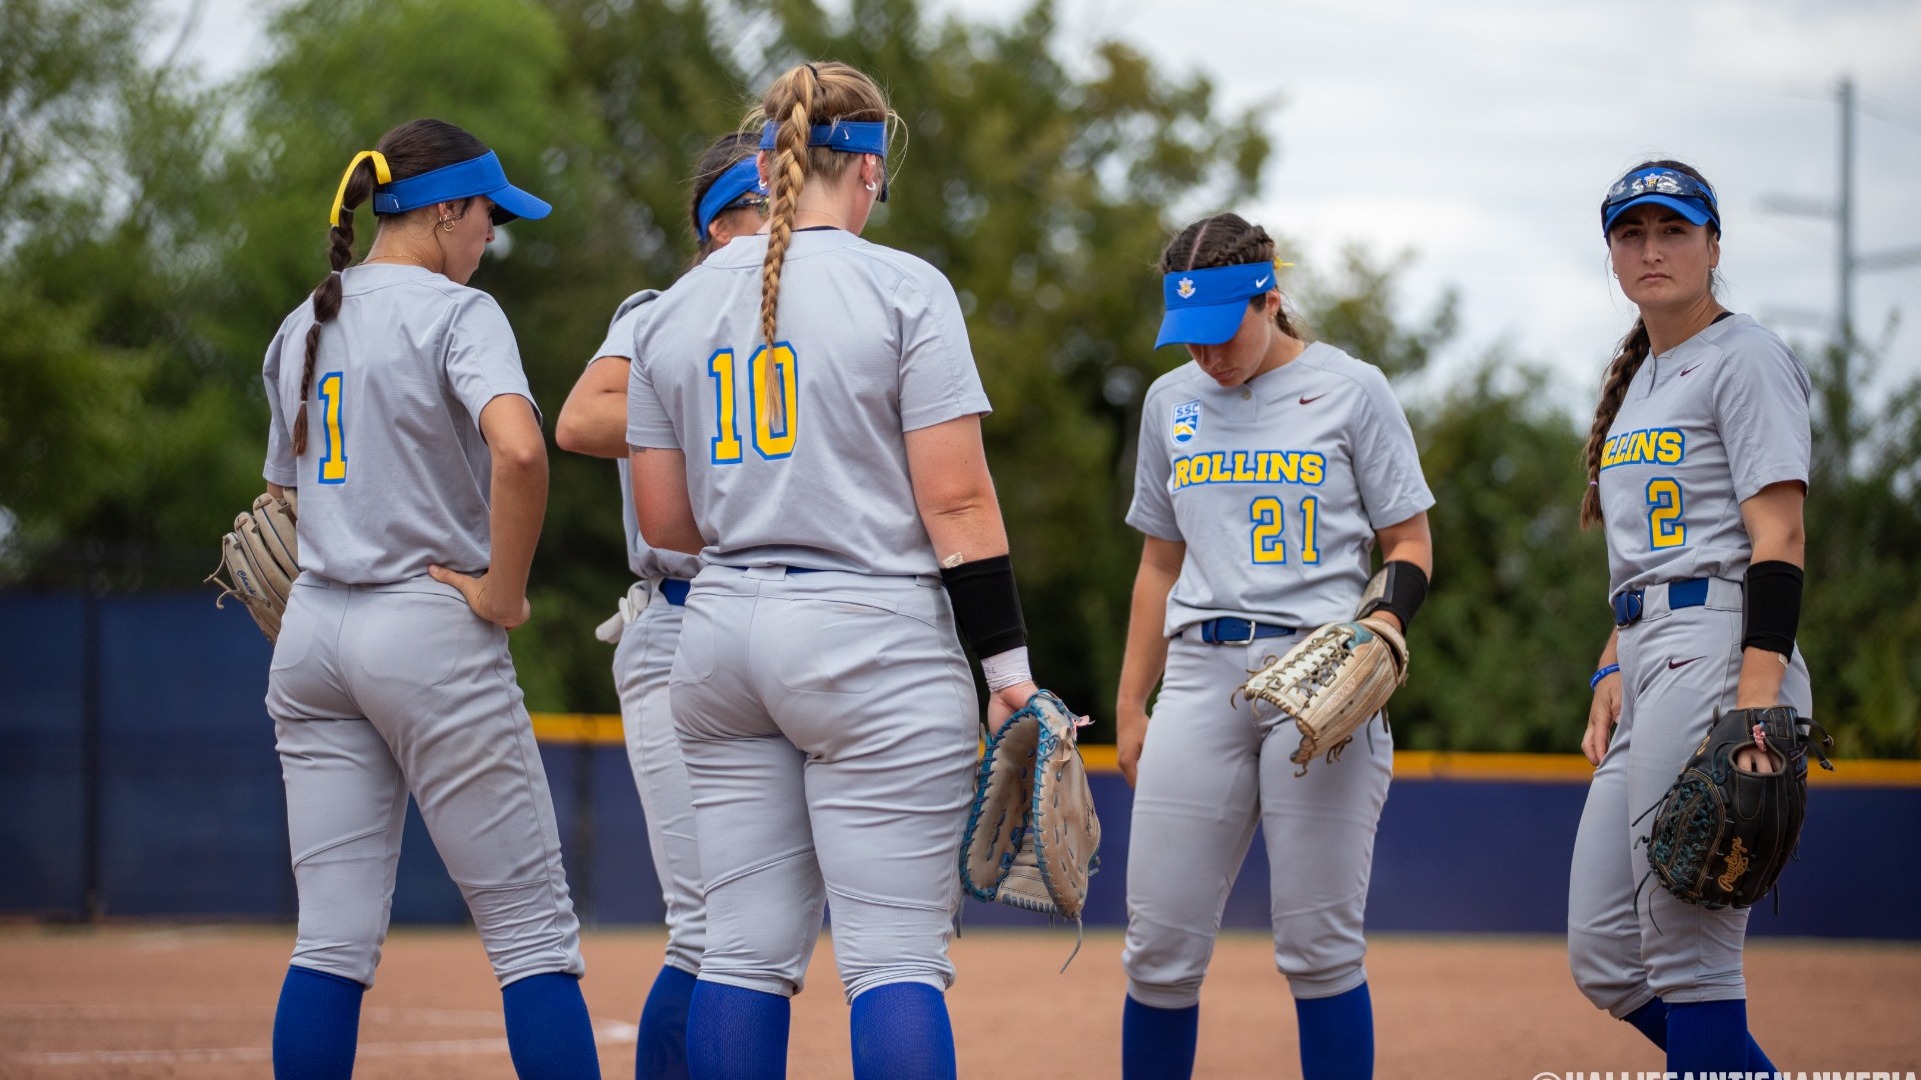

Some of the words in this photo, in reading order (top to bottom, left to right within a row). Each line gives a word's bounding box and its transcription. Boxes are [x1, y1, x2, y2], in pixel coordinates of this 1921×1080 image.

[318, 371, 348, 484] 1
[707, 340, 799, 465] 10
[1176, 403, 1199, 416] SSC
[1173, 450, 1327, 491] ROLLINS
[1250, 495, 1320, 565] 21
[1645, 477, 1688, 551] 2
